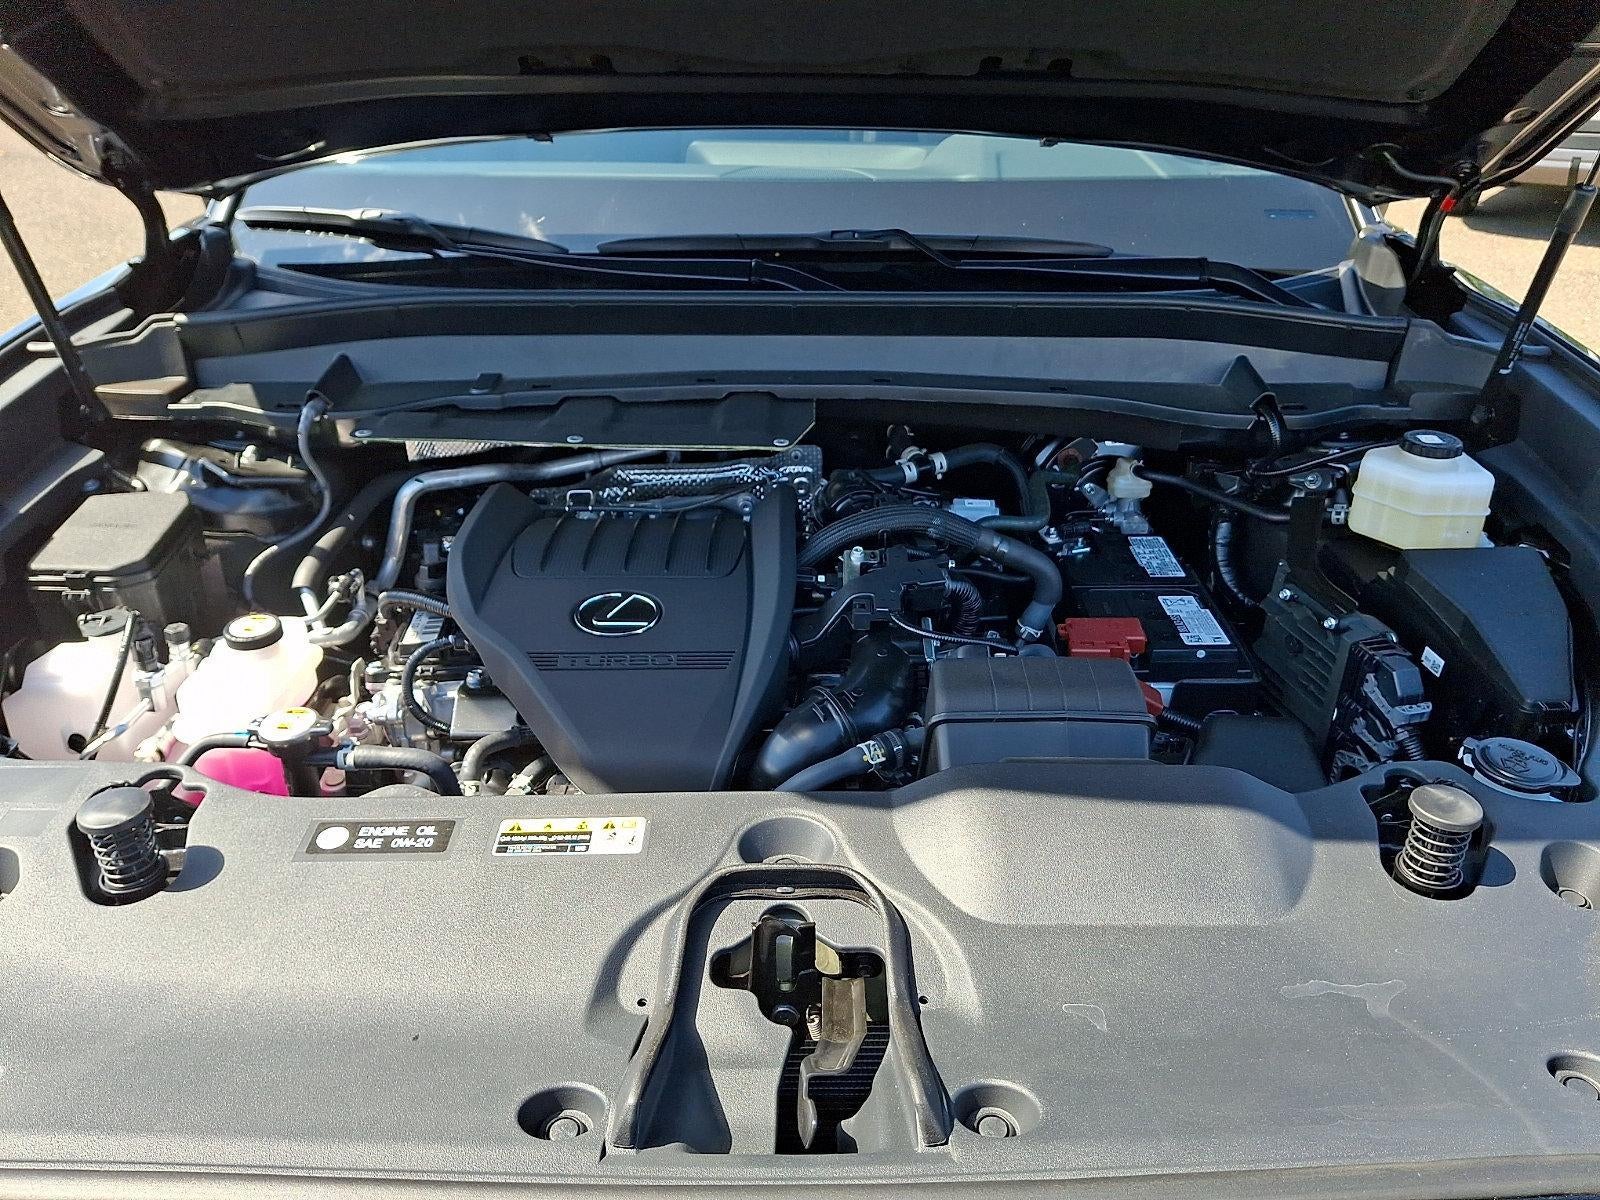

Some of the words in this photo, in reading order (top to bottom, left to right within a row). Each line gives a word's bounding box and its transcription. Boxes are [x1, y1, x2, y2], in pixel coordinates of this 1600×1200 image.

[562, 654, 675, 668] TURBO
[358, 825, 410, 837] ENGINE
[415, 825, 439, 836] OIL
[353, 837, 384, 849] SAE
[390, 837, 435, 848] 0W-20
